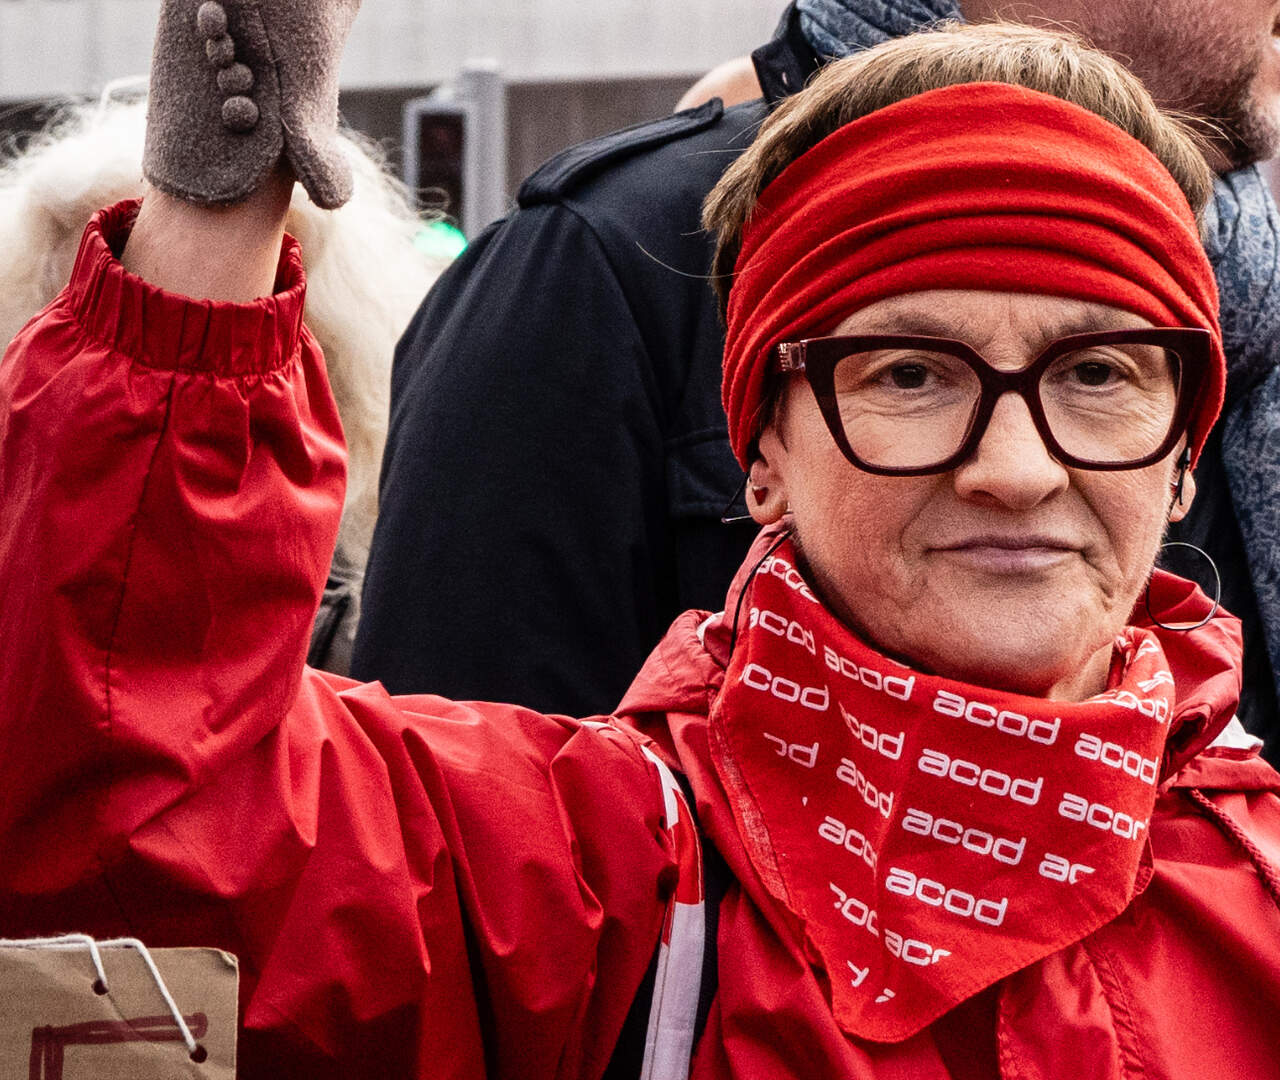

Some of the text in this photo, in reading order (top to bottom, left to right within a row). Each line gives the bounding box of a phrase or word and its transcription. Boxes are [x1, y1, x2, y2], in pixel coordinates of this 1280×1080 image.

[739, 663, 830, 712] cod
[838, 701, 906, 761] cod
[918, 748, 1044, 807] acod
[824, 645, 916, 702] acod
[933, 690, 1061, 746] acod
[1074, 732, 1160, 786] acod
[836, 757, 894, 819] acod
[902, 807, 1026, 866] acod
[885, 866, 1008, 927] acod
